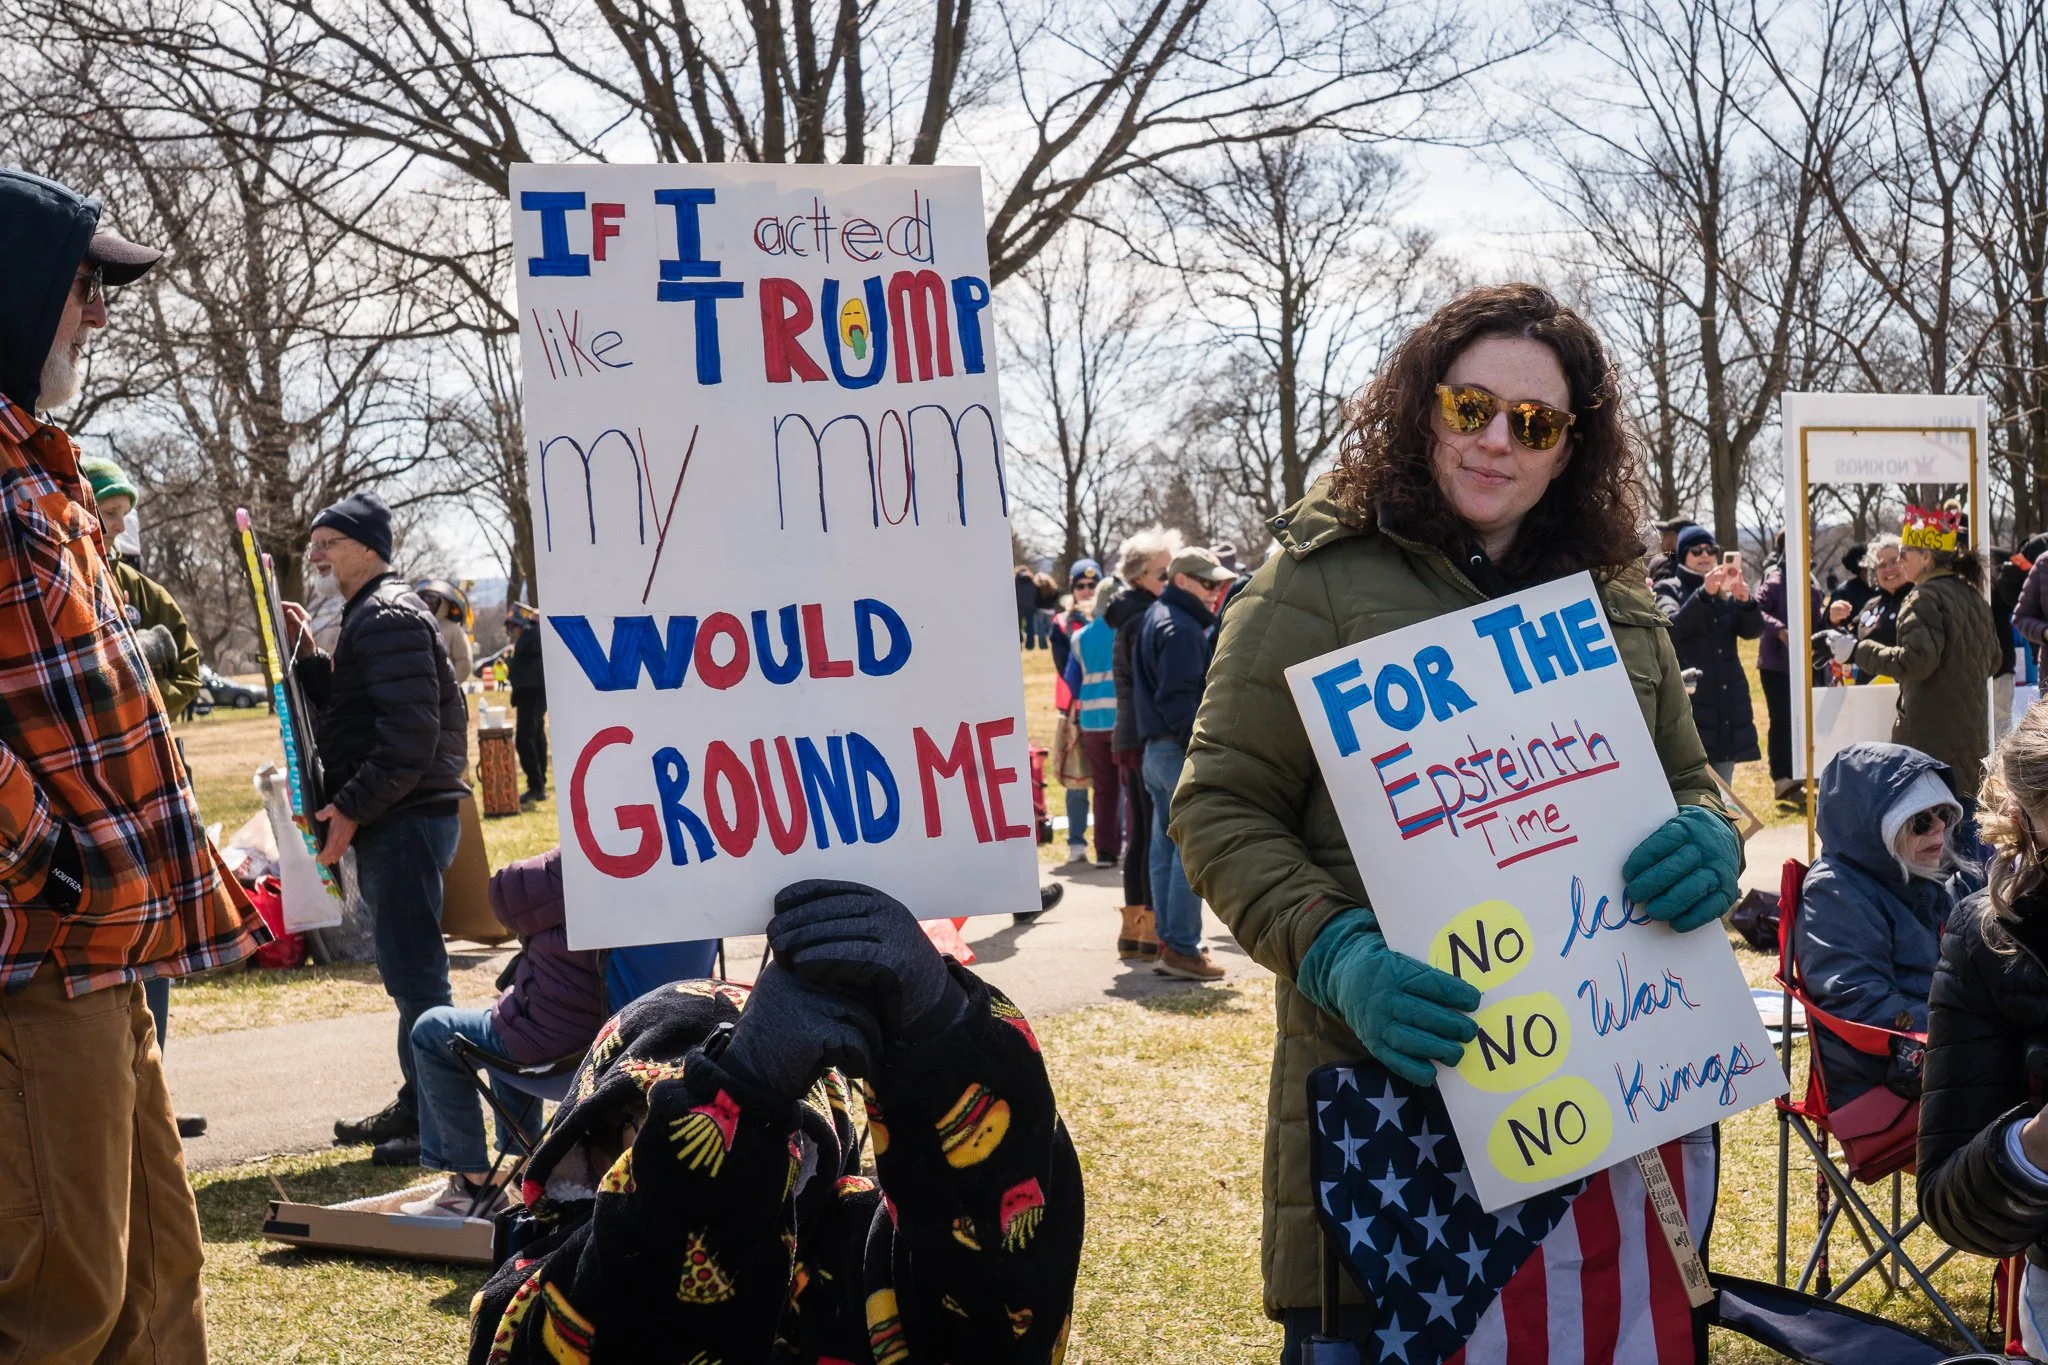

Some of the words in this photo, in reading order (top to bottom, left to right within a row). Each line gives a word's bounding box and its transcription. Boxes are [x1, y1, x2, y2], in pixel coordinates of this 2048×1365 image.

[521, 191, 626, 277] IF
[654, 188, 721, 280] I
[754, 189, 935, 264] acted
[532, 308, 633, 380] like
[657, 269, 990, 389] TRUMP
[539, 424, 699, 605] my
[773, 404, 1008, 533] mom
[547, 598, 912, 692] WOULD
[1311, 645, 1477, 758] FOR
[1472, 597, 1618, 694] THE
[570, 726, 900, 879] GROUND
[912, 717, 1031, 843] ME
[1371, 718, 1616, 838] Epsteinth
[1463, 802, 1571, 857] Time
[1476, 1013, 1557, 1072] NO
[1577, 952, 1701, 1037] War
[1507, 1100, 1587, 1167] NO
[1614, 1042, 1766, 1124] Kings
